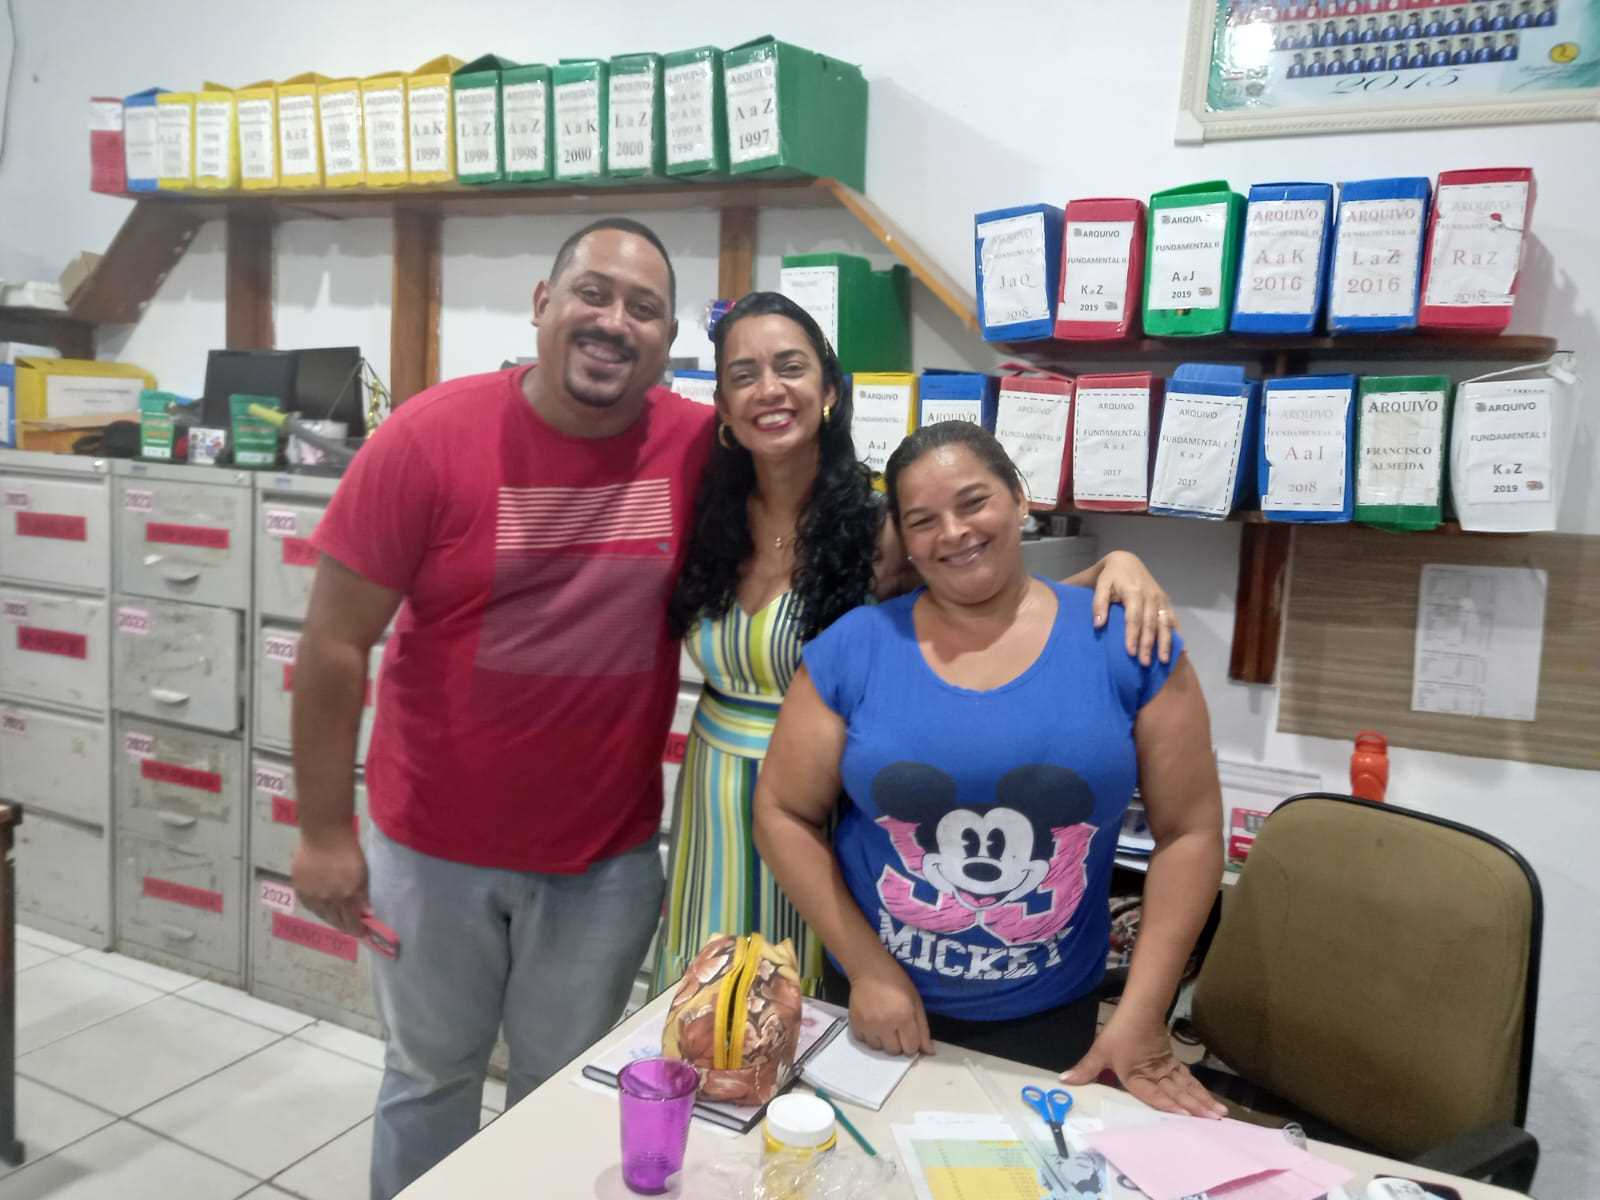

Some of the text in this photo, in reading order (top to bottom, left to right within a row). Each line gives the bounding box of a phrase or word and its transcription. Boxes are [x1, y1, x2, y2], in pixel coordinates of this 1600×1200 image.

[730, 66, 772, 83] ARQUIVO
[1329, 68, 1464, 94] 2015
[736, 106, 745, 121] A
[763, 98, 774, 115] Z
[587, 119, 597, 133] K
[738, 129, 770, 150] 1997
[564, 147, 591, 163] 2000
[615, 142, 644, 156] 2000
[1254, 209, 1319, 222] ARQUIVO
[1346, 207, 1415, 223] ARQUIVO
[1083, 230, 1120, 238] ARQUIVO
[1156, 242, 1214, 251] FUNDAMENTAL
[1068, 256, 1120, 264] FUNDAMENTAL
[1255, 248, 1304, 265] A a K
[1352, 249, 1400, 266] L a Z
[1452, 252, 1498, 266] R a Z
[1020, 272, 1039, 289] Q
[1172, 272, 1180, 282] A
[1189, 271, 1195, 281] J
[1253, 276, 1301, 291] 2016
[1347, 276, 1400, 294] 2016
[1081, 285, 1088, 295] K
[1096, 285, 1103, 295] Z
[1171, 289, 1191, 298] 2019
[1080, 303, 1098, 311] 2019
[1098, 402, 1134, 410] ARQUIVO
[1368, 399, 1438, 413] ARQUIVO
[1488, 402, 1537, 412] ARQUIVO
[1178, 410, 1218, 419] ARQUIVO
[1281, 409, 1334, 421] ARQUIVO
[1162, 435, 1222, 447] FUNDAMENTAL
[1470, 431, 1541, 442] FUNDAMENTAL
[868, 441, 875, 450] A
[1366, 446, 1432, 455] FRANCISCO
[1285, 446, 1299, 460] A
[1304, 450, 1313, 460] a
[1373, 461, 1424, 470] ALMEIDA
[1493, 464, 1502, 474] K
[1514, 463, 1523, 474] Z
[1103, 469, 1121, 477] 2017
[1177, 478, 1198, 487] 2017
[1287, 481, 1317, 493] 2018
[1493, 484, 1518, 493] 2019
[262, 886, 293, 907] 2022
[879, 908, 1074, 981] MICKEY
